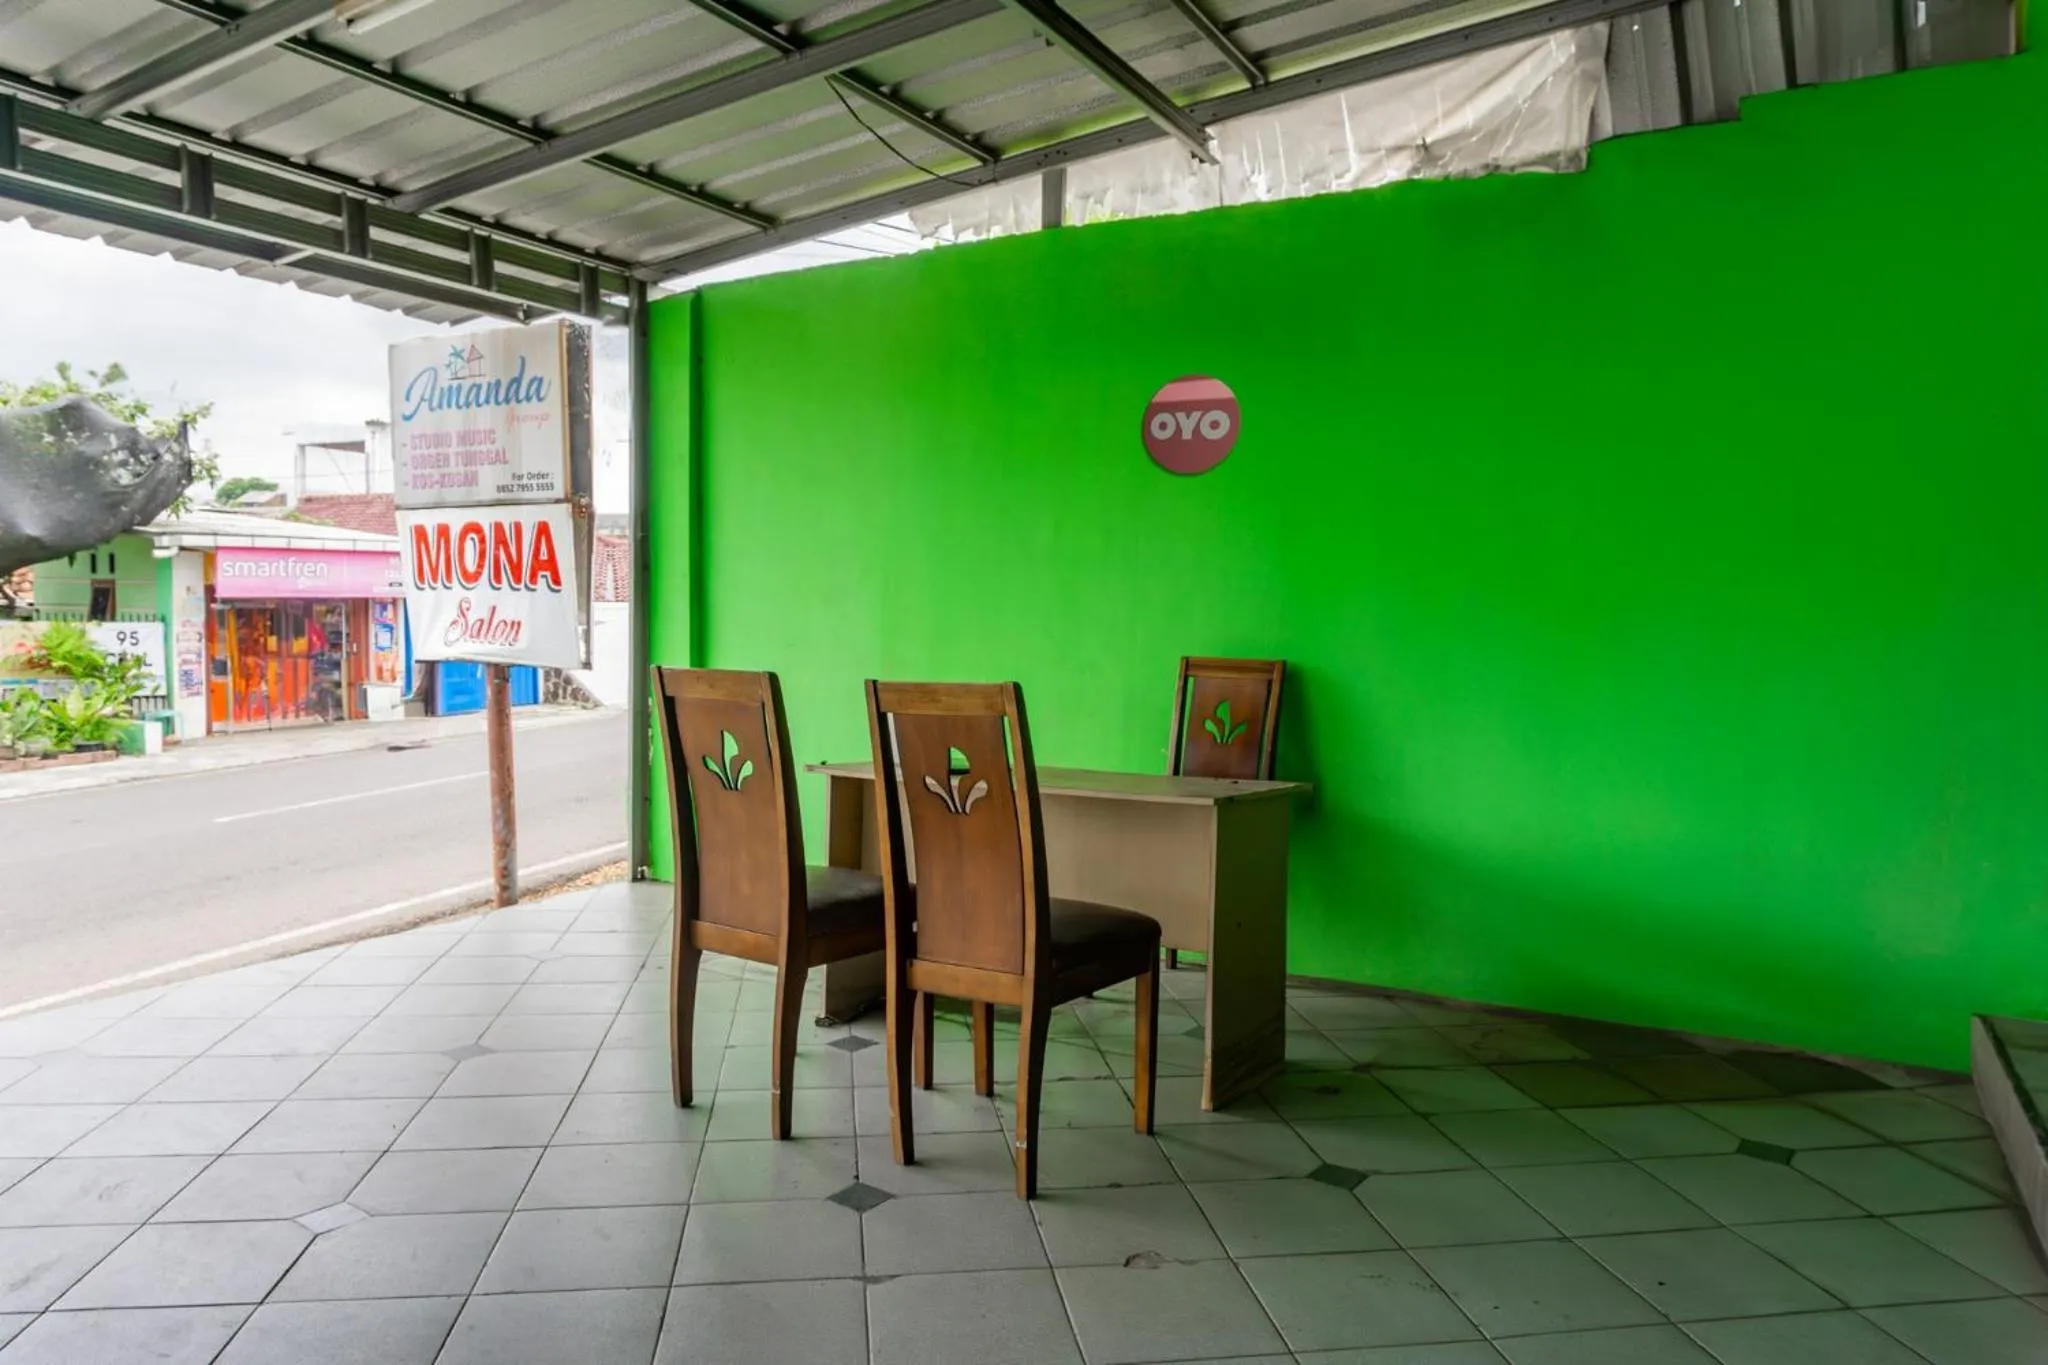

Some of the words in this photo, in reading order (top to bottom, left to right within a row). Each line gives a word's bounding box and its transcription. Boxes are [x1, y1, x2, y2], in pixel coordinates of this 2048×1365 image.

[402, 355, 551, 421] Amanda
[1150, 409, 1231, 440] OYO
[410, 432, 452, 450] STUDIO
[456, 428, 496, 447] MUSIC
[512, 473, 524, 481] For
[222, 557, 328, 577] smartfren
[411, 520, 562, 592] MONA
[444, 597, 522, 647] Salon
[116, 630, 139, 646] 95
